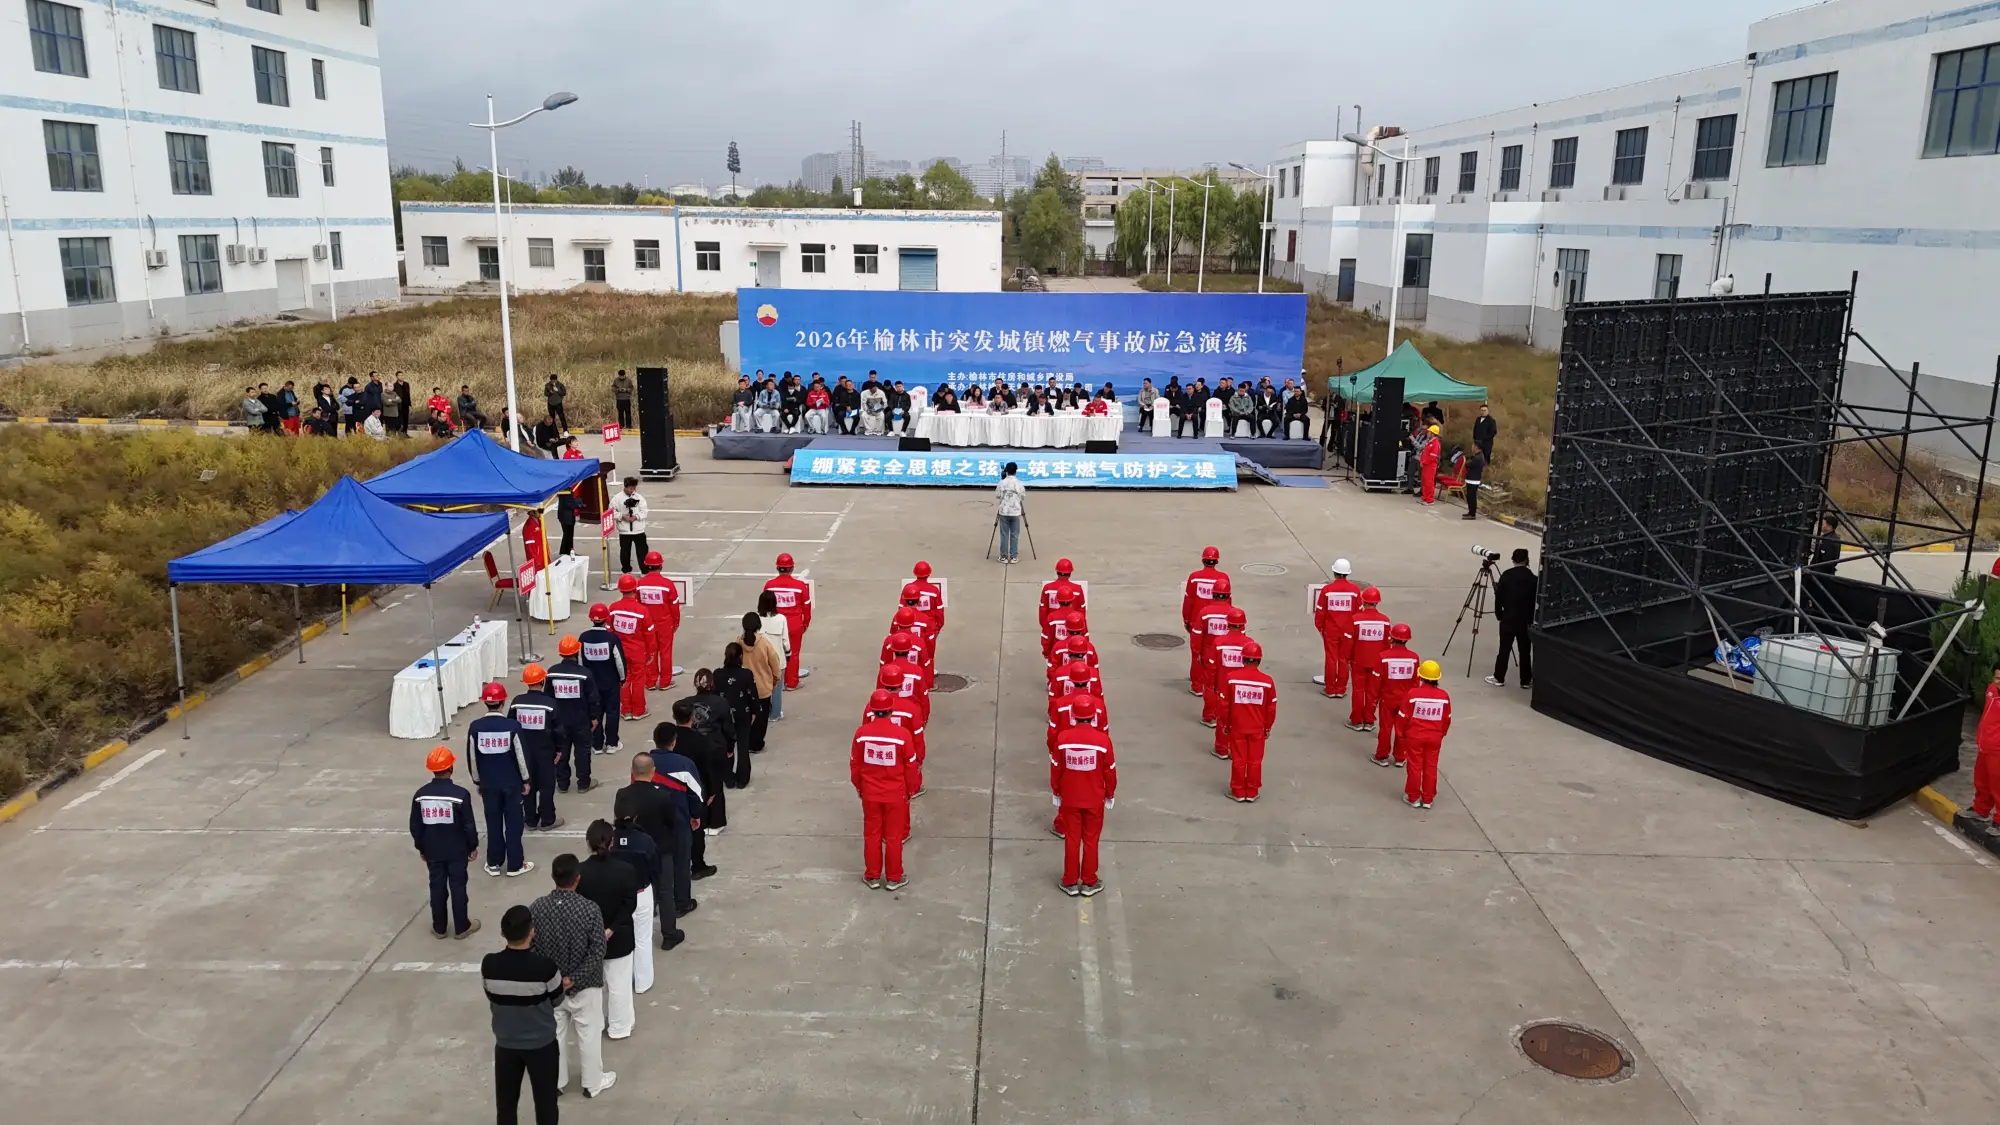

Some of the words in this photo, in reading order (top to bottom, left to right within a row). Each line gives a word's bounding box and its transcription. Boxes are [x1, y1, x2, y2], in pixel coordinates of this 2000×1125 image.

[795, 328, 1248, 354] 2026年榆林市突发城镇燃气事故应急演练
[615, 619, 634, 629] 工程组
[480, 737, 509, 748] 工程检测组
[867, 749, 893, 760] 警戒组
